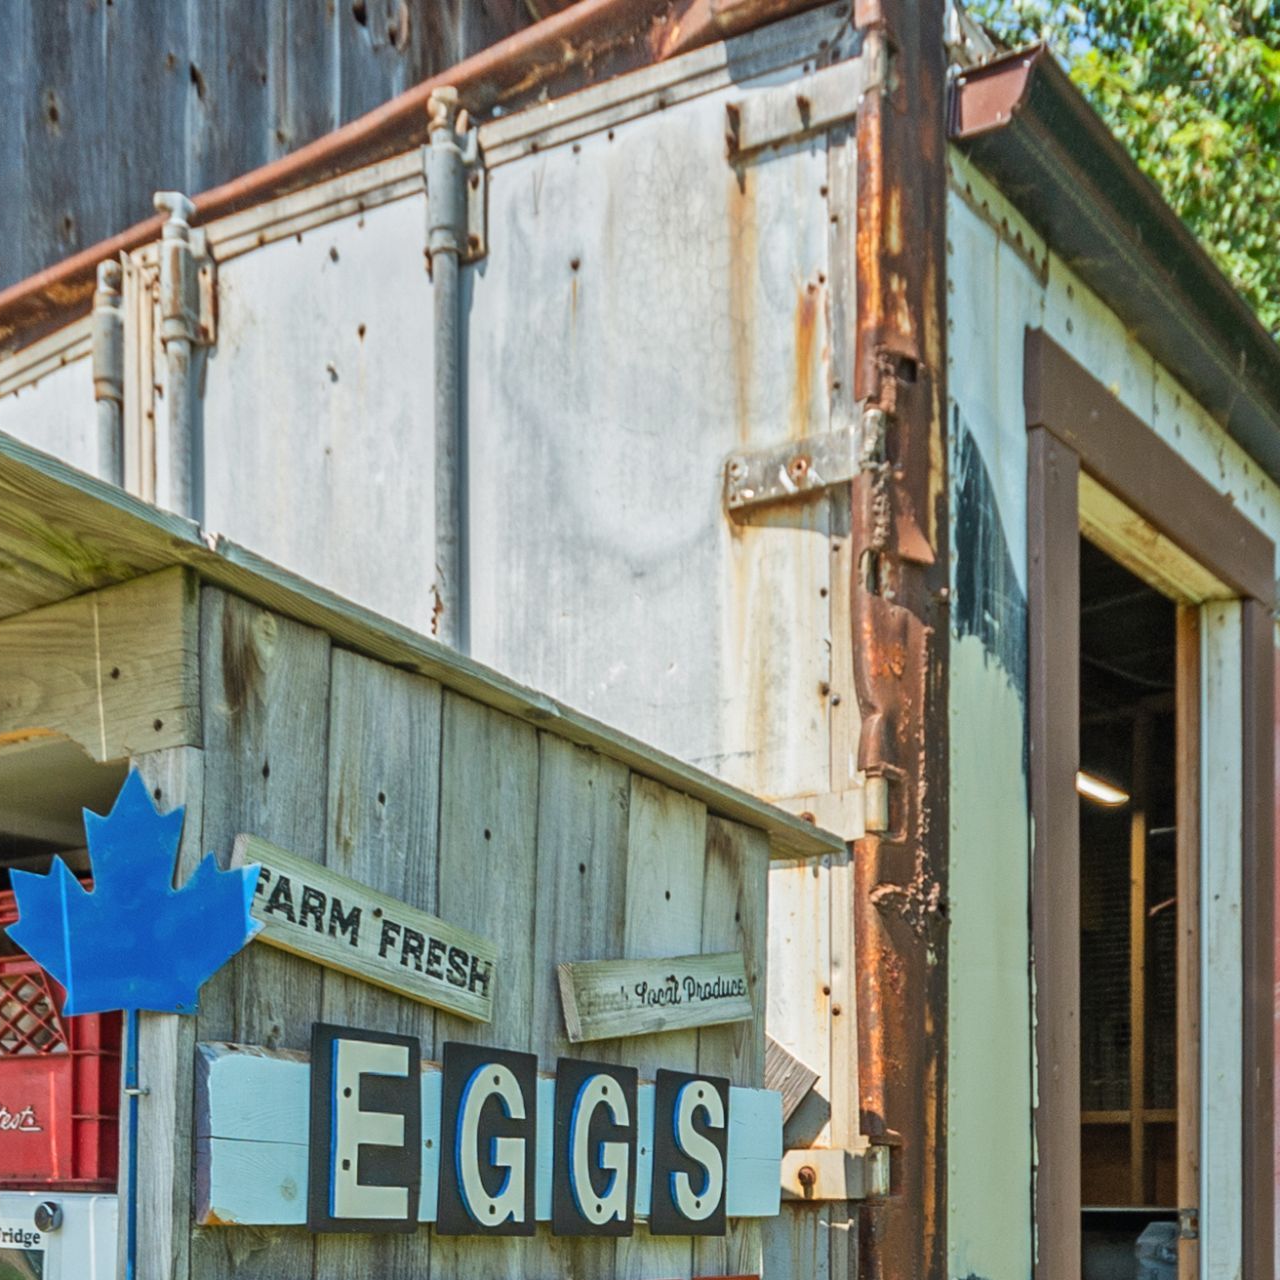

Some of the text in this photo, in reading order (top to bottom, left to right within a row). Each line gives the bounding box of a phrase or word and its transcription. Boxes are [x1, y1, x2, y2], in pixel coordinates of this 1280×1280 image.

[378, 919, 493, 997] FRESH
[634, 974, 682, 1008] Local
[682, 974, 747, 1003] Produce
[329, 1038, 725, 1227] EGGS
